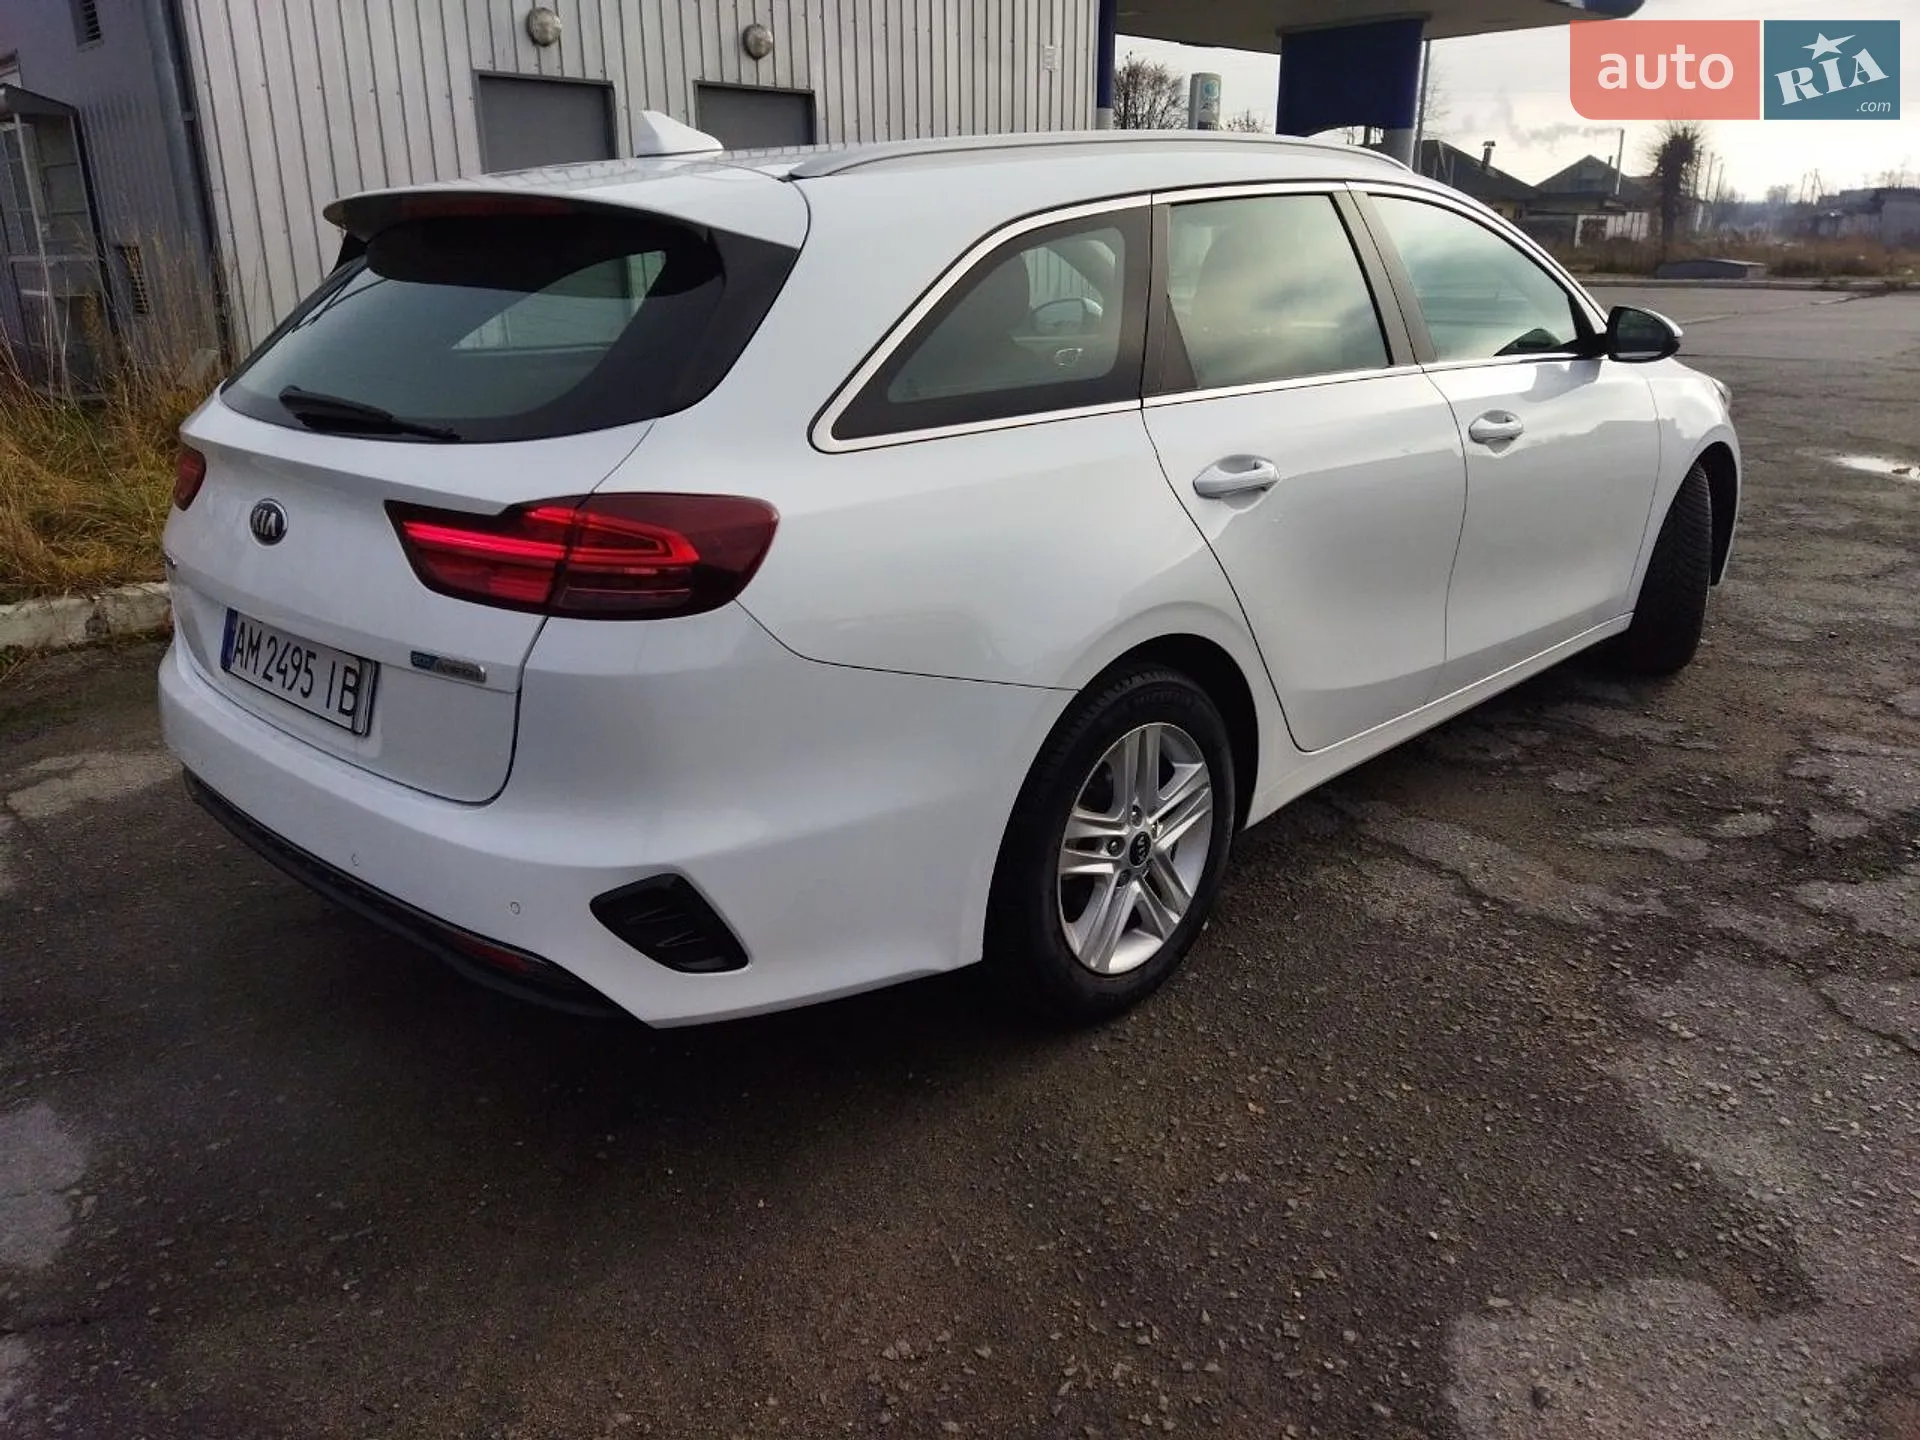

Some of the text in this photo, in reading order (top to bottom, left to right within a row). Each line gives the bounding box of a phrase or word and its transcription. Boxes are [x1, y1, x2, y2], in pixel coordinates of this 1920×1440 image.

[252, 508, 277, 537] KIA
[232, 621, 263, 675] AM
[262, 636, 317, 700] 2495
[326, 661, 360, 717] IB
